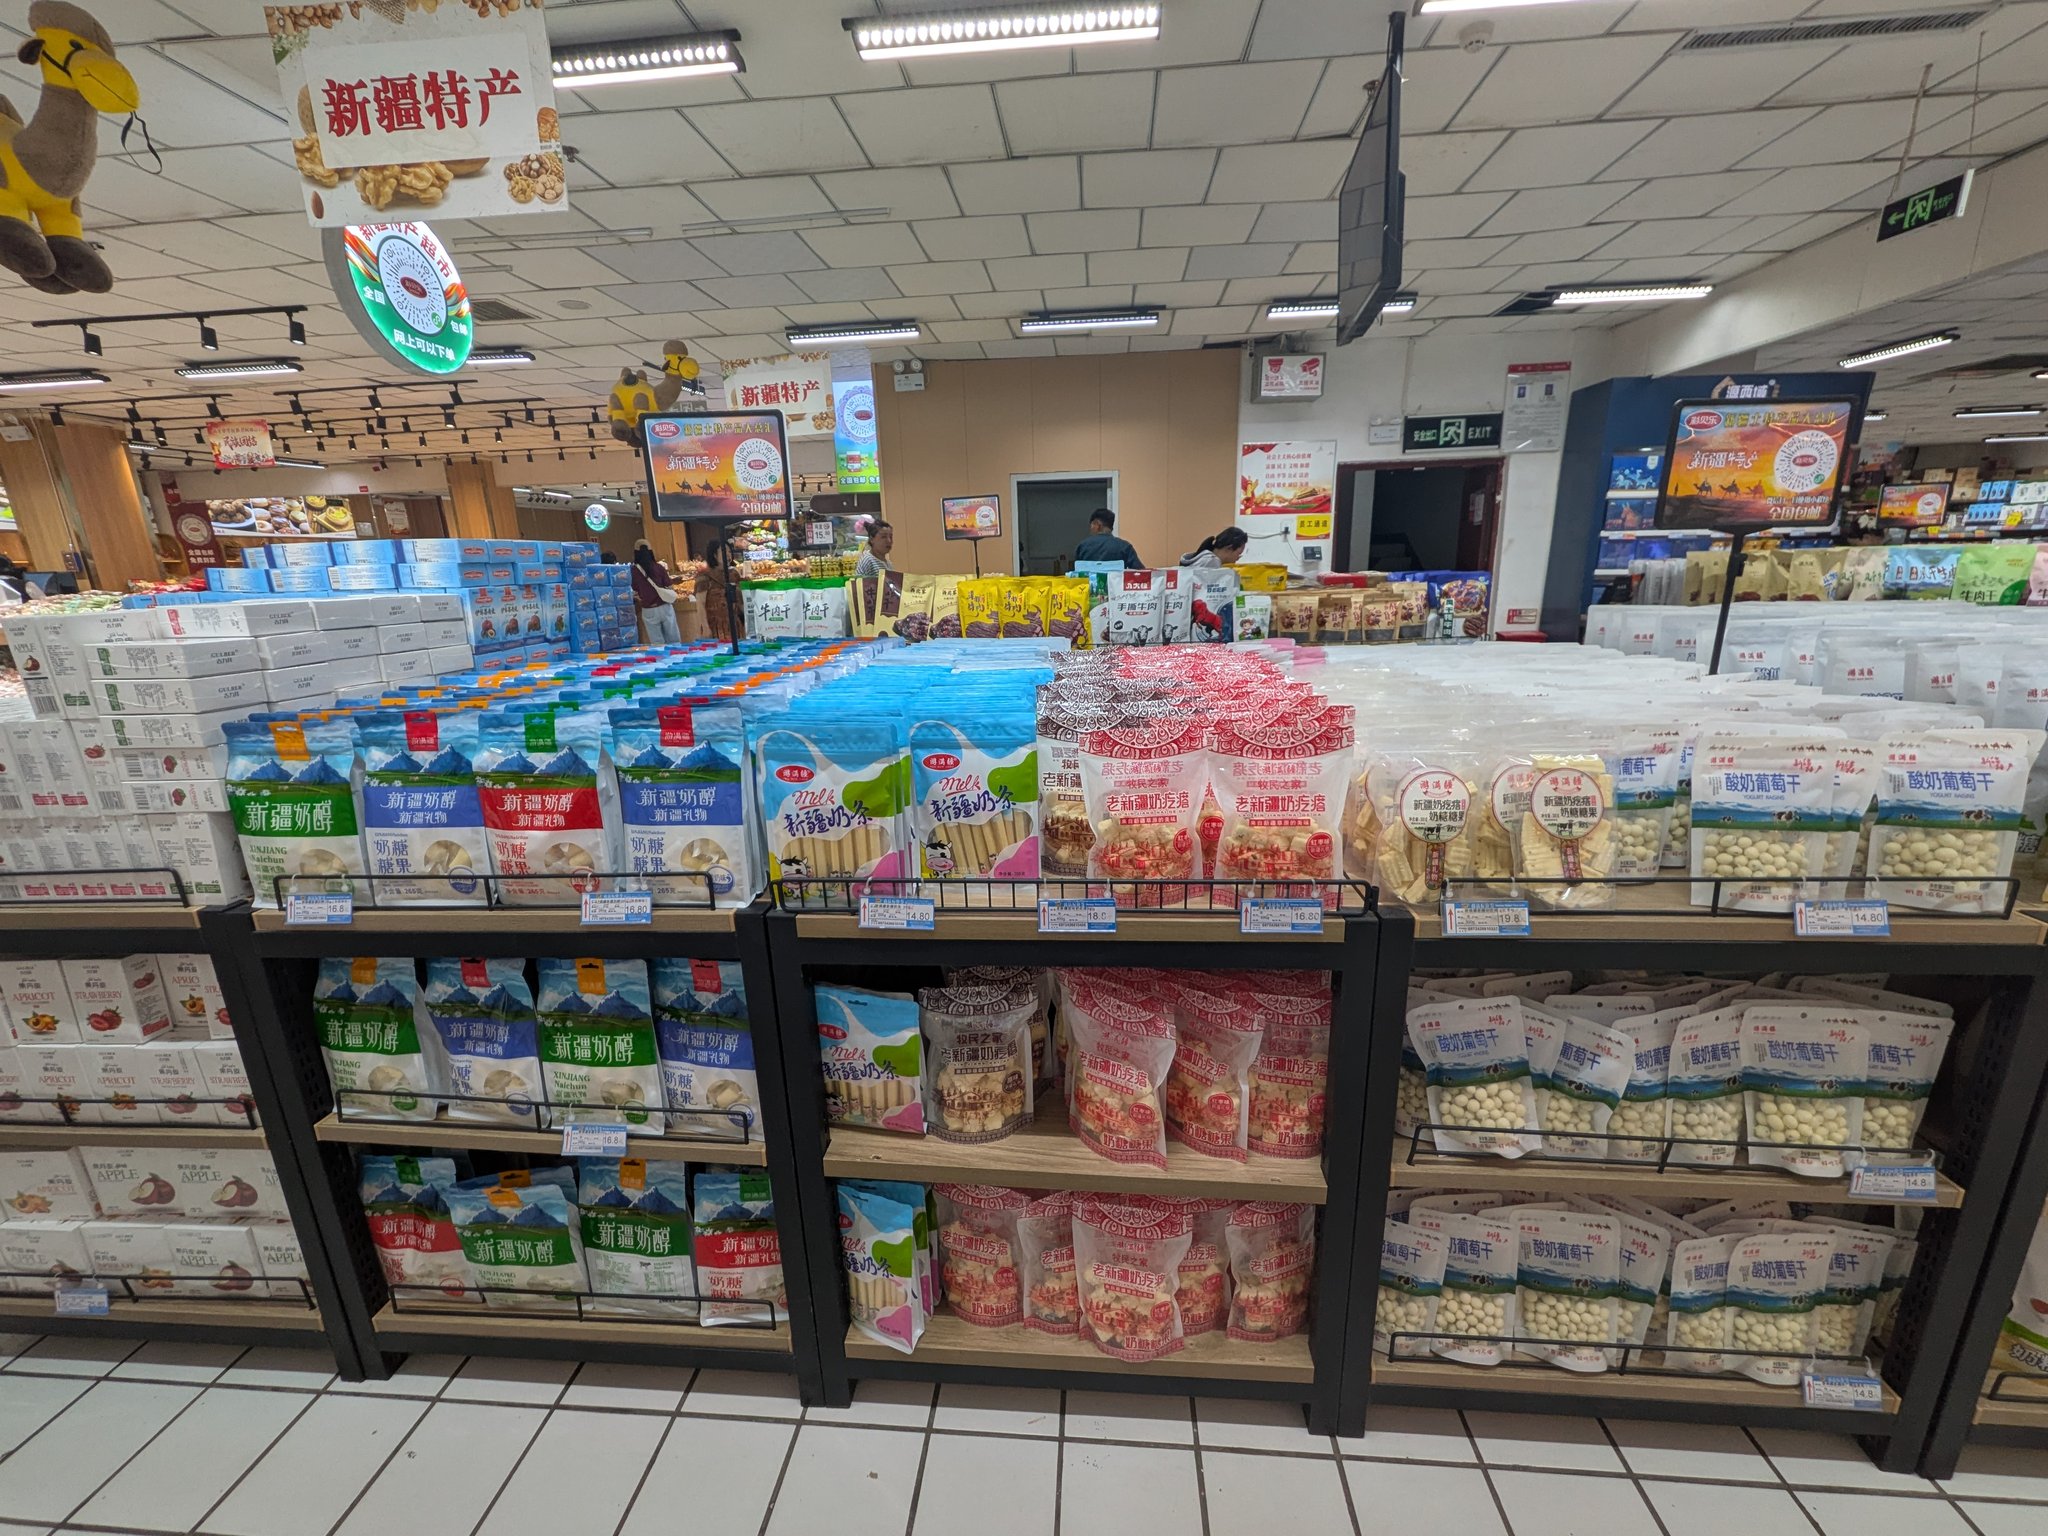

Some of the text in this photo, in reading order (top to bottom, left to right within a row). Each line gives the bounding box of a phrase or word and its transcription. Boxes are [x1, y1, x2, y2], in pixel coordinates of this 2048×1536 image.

[321, 67, 522, 137] 新疆特产
[363, 285, 385, 305] 全国
[450, 320, 468, 336] 包邮
[393, 329, 456, 361] 网上可以下单
[741, 379, 821, 407] 新疆特产
[1414, 430, 1437, 441] 安全出口
[1467, 426, 1492, 439] EXIT
[741, 502, 782, 513] 全国包邮
[1769, 506, 1822, 520] 全国包邮
[1300, 520, 1328, 528] 员工通道
[1960, 589, 1998, 602] 牛肉干
[758, 602, 791, 621] 牛肉干
[803, 601, 829, 620] 牛肉干
[1118, 602, 1158, 611] 手撕牛肉
[939, 775, 981, 793] Milk
[1043, 773, 1083, 788] 老新疆
[1126, 777, 1169, 789] 牧民之家
[1259, 780, 1303, 790] 牧民之家
[1724, 772, 1801, 794] 酸奶葡萄干
[1906, 771, 1995, 792] 酸奶葡萄干
[380, 789, 458, 811] 新疆奶醇
[497, 792, 574, 812] 新疆奶醇
[636, 786, 716, 806] 新疆奶醇
[792, 788, 836, 808] Milk
[930, 785, 1017, 823] 新疆奶条
[1106, 791, 1190, 813] 老新疆奶疙瘩
[1235, 794, 1326, 813] 老新疆奶疙瘩
[1413, 799, 1461, 811] 新疆奶疙瘩
[1543, 795, 1592, 807] 新疆奶疙瘩
[243, 800, 335, 834] 新疆奶醇
[393, 811, 448, 826] 新疆礼物
[512, 813, 566, 828] 新疆礼物
[647, 808, 708, 822] 新疆礼物
[784, 800, 873, 838] 新疆奶条
[1428, 811, 1465, 823] 奶糖糖果
[1560, 806, 1598, 819] 奶糖糖果
[250, 844, 288, 855] XINJIANG
[373, 839, 409, 857] 奶糖
[495, 840, 527, 859] 奶糖
[630, 836, 664, 855] 奶糖
[376, 858, 417, 875] 糖果
[633, 855, 672, 873] 糖果
[624, 905, 648, 914] 16.80
[906, 911, 931, 921] 14.80
[1295, 911, 1320, 921] 16.80
[1855, 911, 1884, 924] 14.80
[13, 991, 56, 1001] APRICOT
[74, 990, 123, 1000] STRAWBERRY
[326, 1019, 399, 1052] 新疆奶醇
[448, 1021, 510, 1043] 新疆奶醇
[671, 1027, 740, 1052] 新疆奶醇
[956, 1032, 1003, 1045] 牧民之家
[1436, 1028, 1500, 1053] 酸奶葡萄干
[549, 1031, 635, 1065] 新疆奶醇
[683, 1047, 730, 1065] 新疆礼物
[830, 1045, 866, 1060] Milk
[941, 1040, 1018, 1063] 老新疆奶疙瘩
[1690, 1039, 1740, 1066] 酸奶葡萄干
[1766, 1039, 1840, 1062] 酸奶葡萄干
[553, 1070, 591, 1082] XINJIANG
[822, 1060, 899, 1081] 新疆奶条
[1079, 1050, 1149, 1088] 老新疆奶疙瘩
[38, 1076, 76, 1084] APRICOT
[97, 1076, 137, 1085] APRICOT
[150, 1076, 196, 1085] STRAWBERRY
[1102, 1131, 1154, 1150] 奶糖糖果
[1182, 1121, 1233, 1146] 奶糖糖果
[97, 1169, 140, 1181] APPLE
[182, 1170, 223, 1182] APPLE
[592, 1221, 672, 1255] 新疆奶醇
[942, 1230, 1009, 1256] 老新疆奶疙瘩
[470, 1239, 556, 1264] 新疆奶醇
[1532, 1238, 1595, 1263] 酸奶葡萄干
[180, 1254, 220, 1266] APPLE
[1092, 1262, 1166, 1286] 老新疆奶疙瘩
[1751, 1260, 1808, 1281] 酸奶葡萄干
